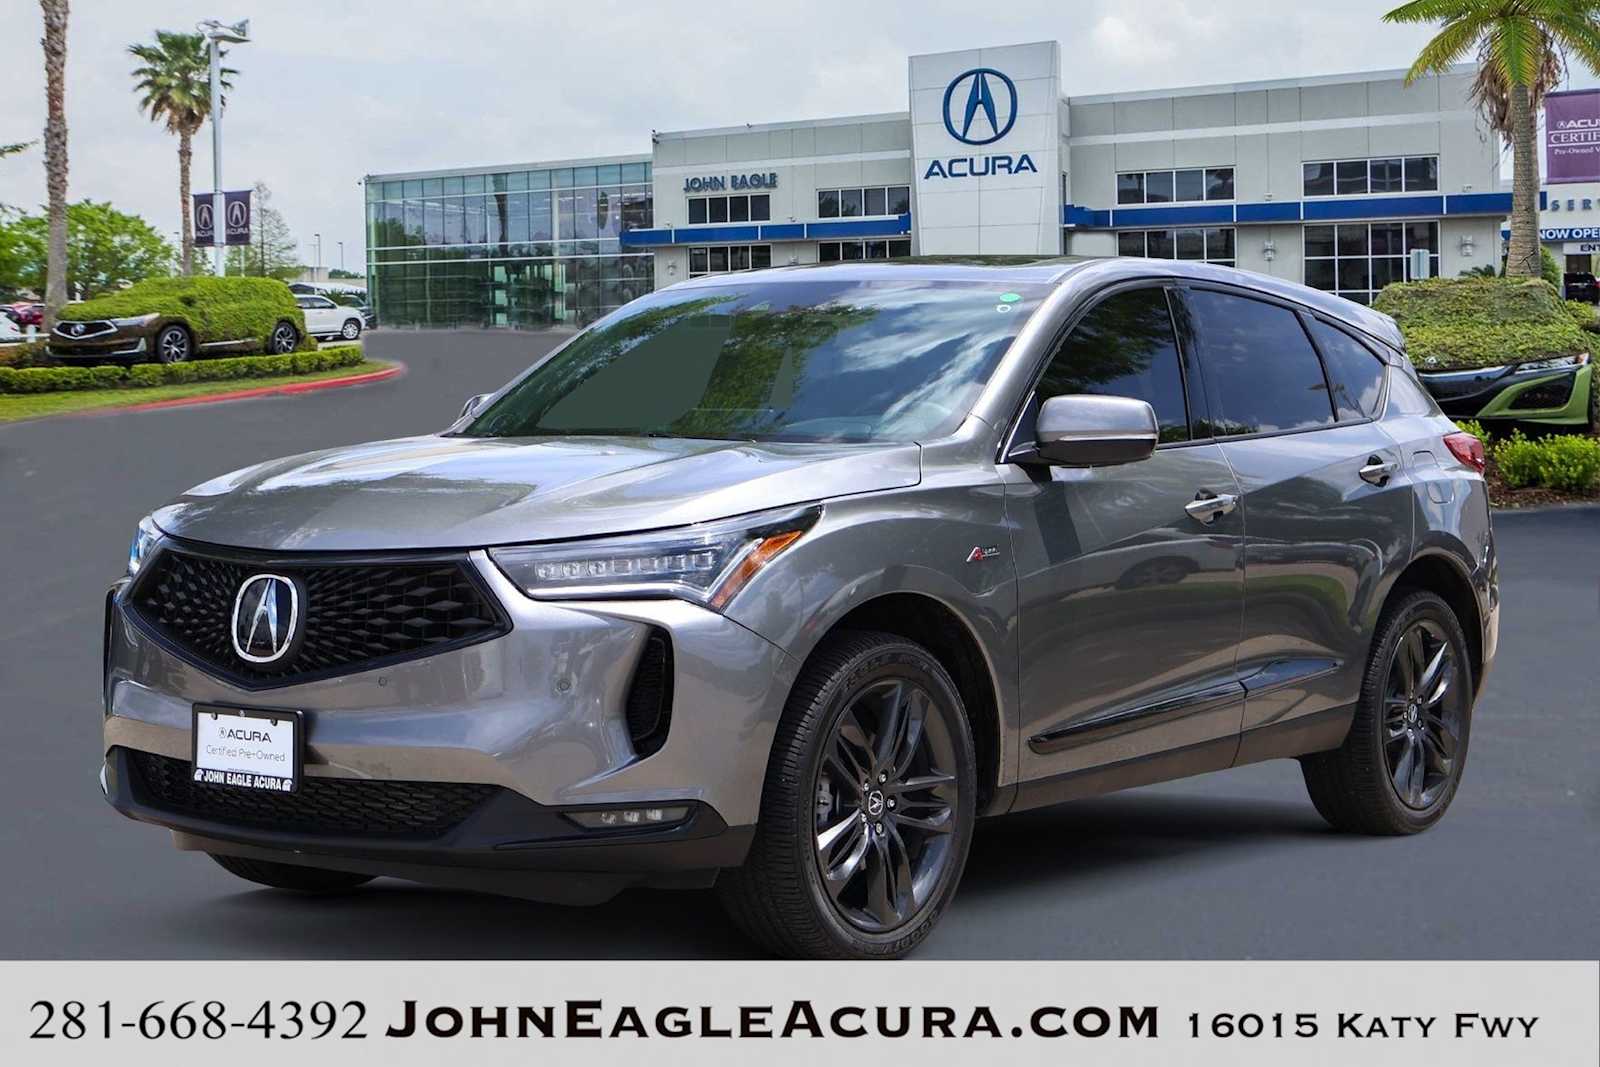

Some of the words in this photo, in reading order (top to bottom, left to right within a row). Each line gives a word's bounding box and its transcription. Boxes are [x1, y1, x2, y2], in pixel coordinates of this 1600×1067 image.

[1567, 119, 1600, 128] ACU
[924, 154, 1037, 180] ACURA
[683, 175, 725, 192] JOHN
[731, 172, 777, 190] EAGLE
[1551, 199, 1600, 211] SER
[1572, 228, 1600, 238] OPE
[227, 729, 272, 743] ACURA
[207, 744, 237, 757] Certified
[239, 748, 286, 762] Pre-Owned
[203, 770, 225, 784] JOHN
[226, 773, 252, 787] EAGLE
[253, 776, 281, 790] ACURA
